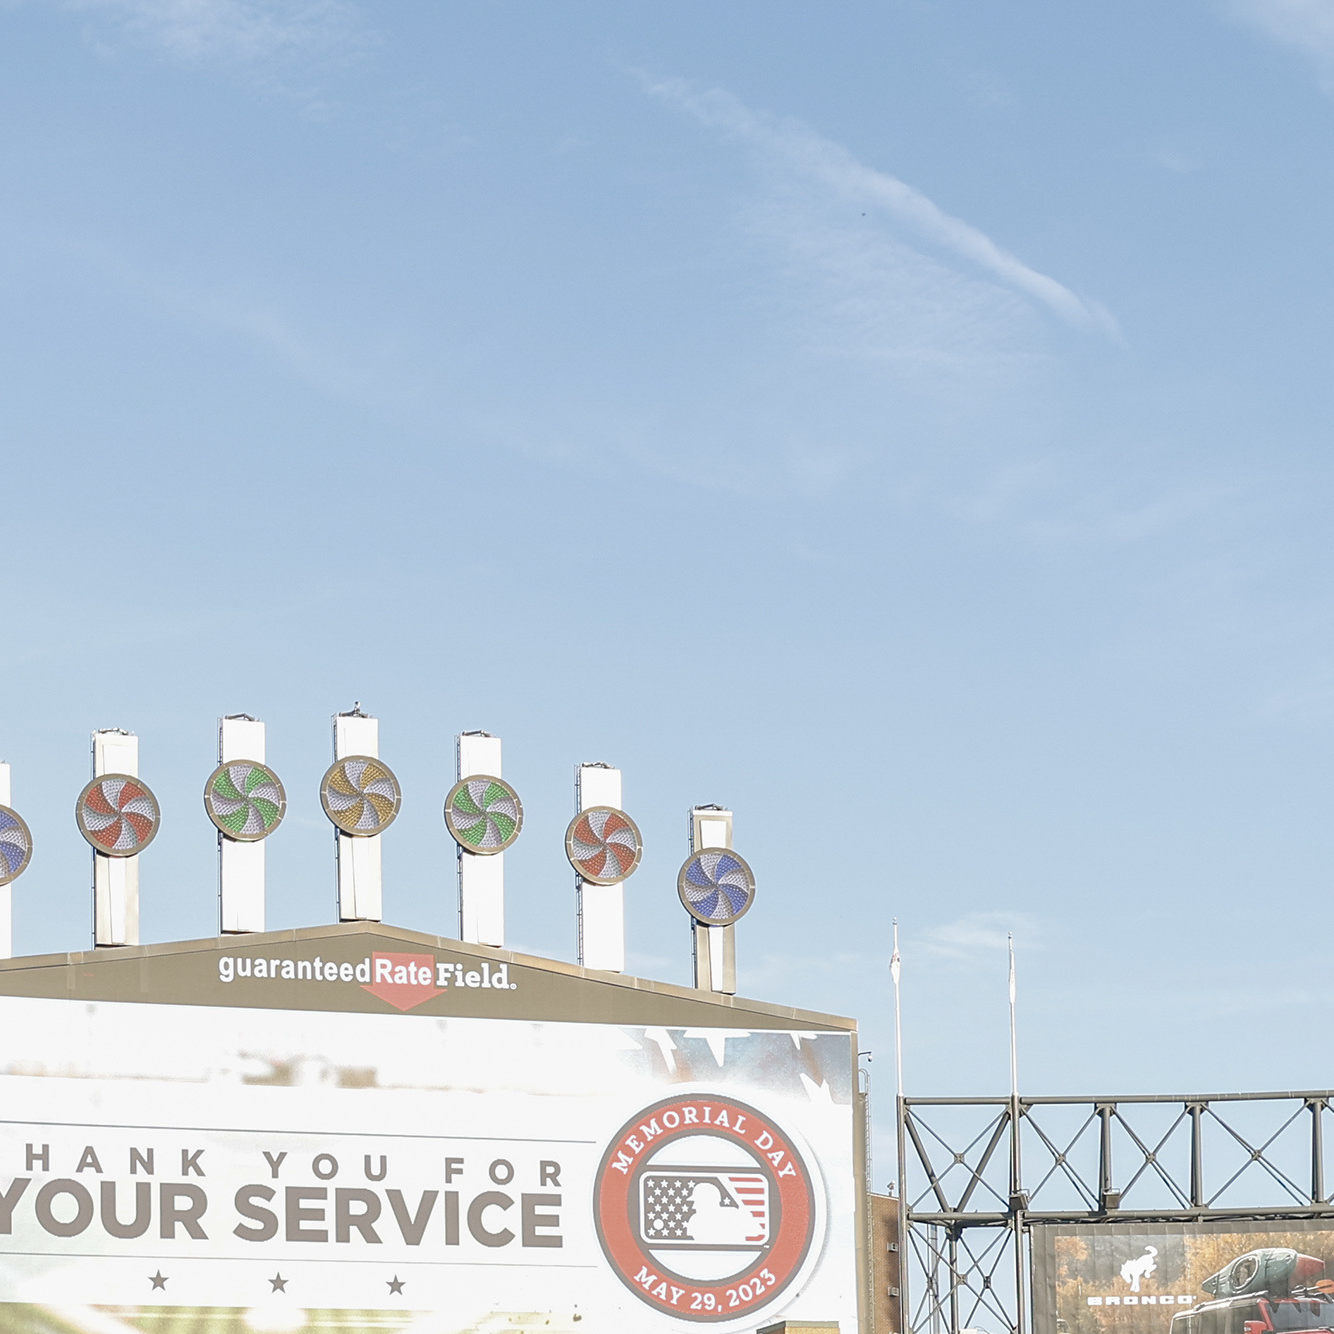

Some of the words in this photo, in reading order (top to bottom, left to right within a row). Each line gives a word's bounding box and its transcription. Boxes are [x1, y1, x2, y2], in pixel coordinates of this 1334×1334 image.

[218, 956, 371, 982] guaranteed
[375, 958, 432, 986] Rate
[611, 1106, 747, 1175] MEMORIAL
[753, 1130, 797, 1179] DAY
[262, 1151, 388, 1182] YOU
[444, 1157, 562, 1187] FOR
[231, 1184, 563, 1249] SERVICE
[633, 1265, 685, 1305] MAY
[689, 1293, 723, 1313] 29,
[725, 1267, 776, 1308] 2023
[1087, 1295, 1194, 1306] BRONCO
